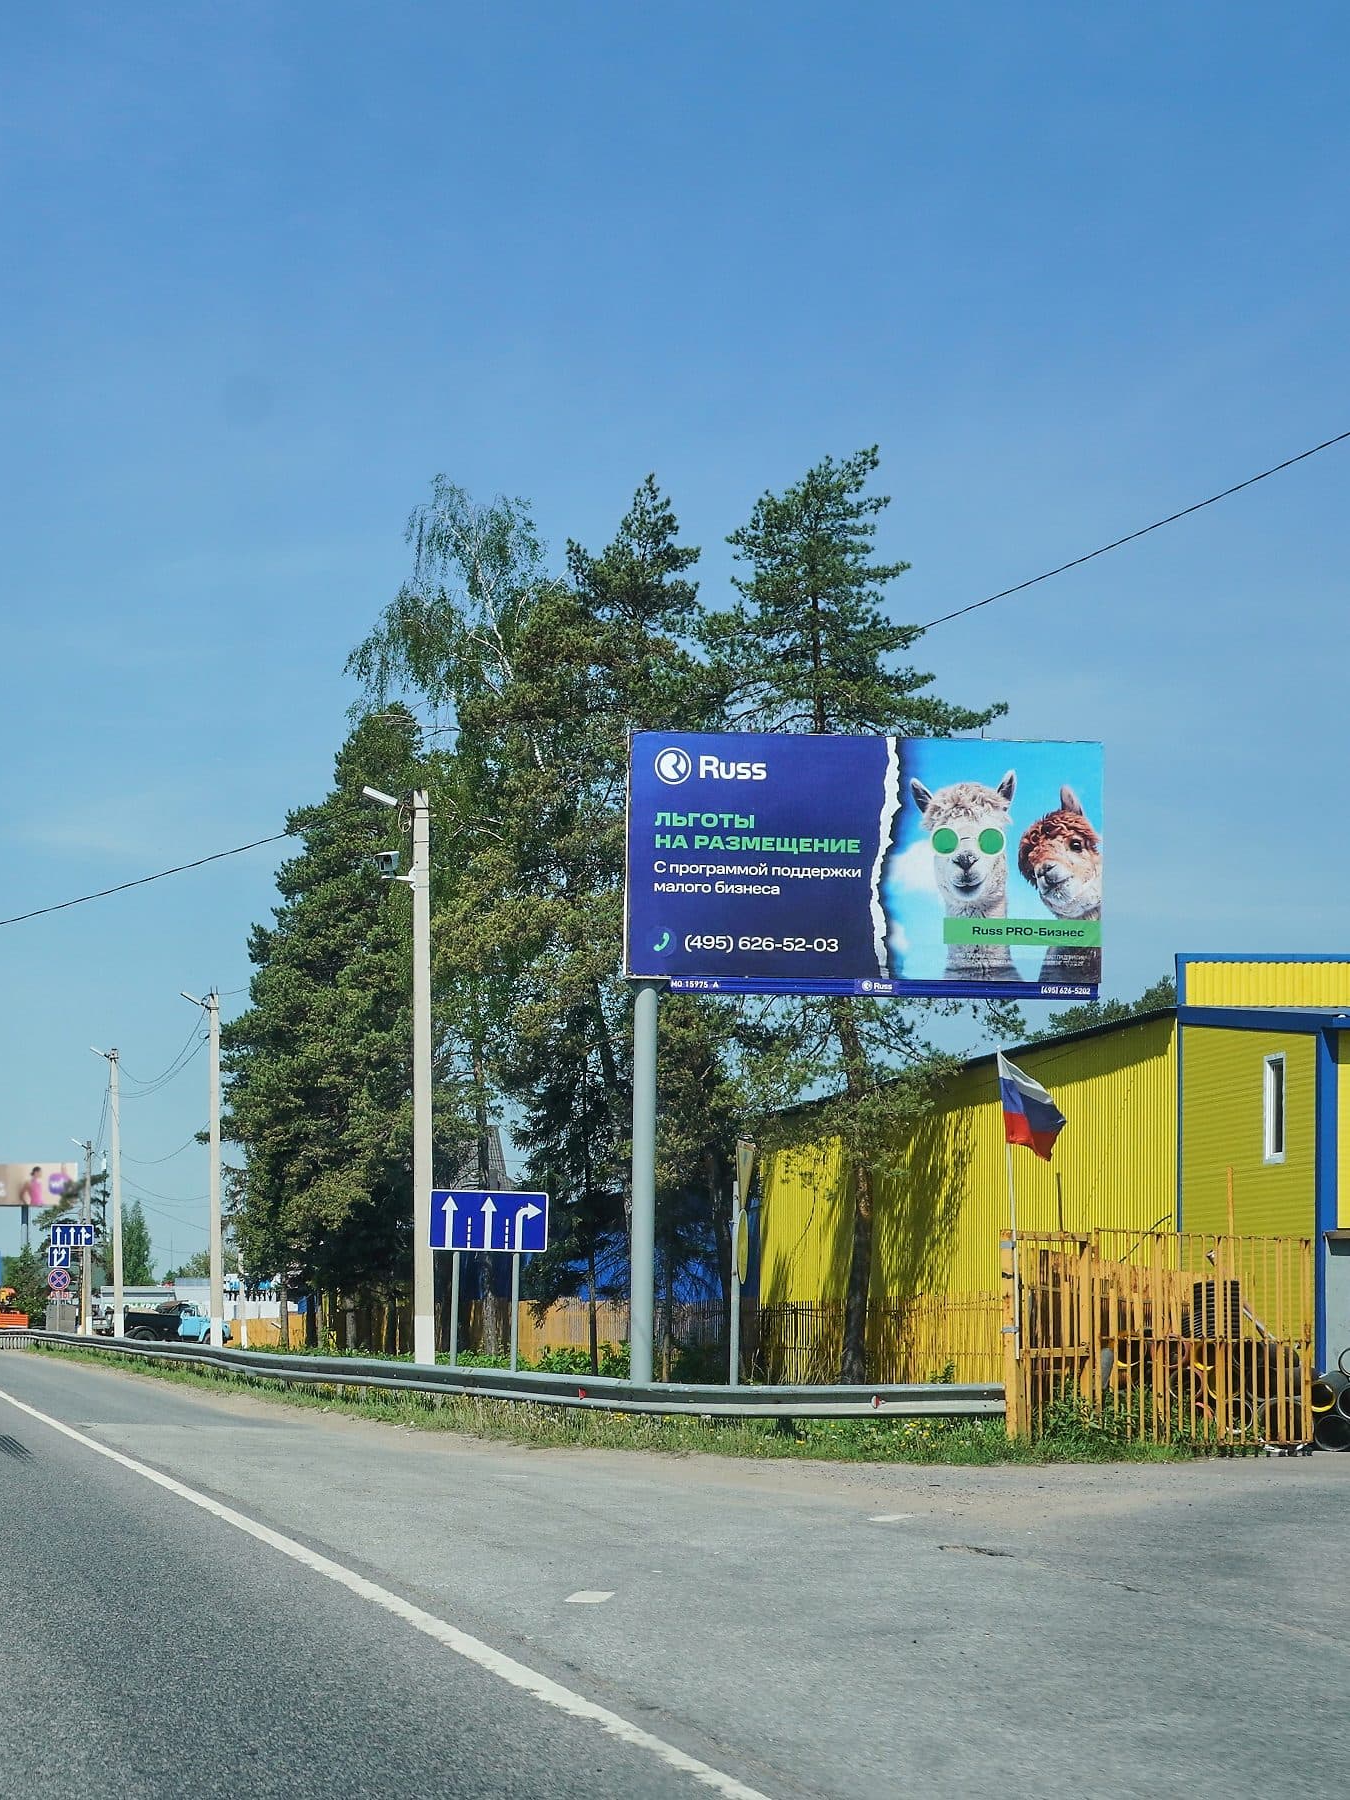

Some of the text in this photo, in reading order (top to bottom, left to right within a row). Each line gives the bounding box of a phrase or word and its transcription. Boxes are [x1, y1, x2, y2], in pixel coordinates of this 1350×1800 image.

[699, 755, 768, 780] Russ
[654, 812, 755, 829] ЛЬГОТЫ
[655, 834, 861, 854] НА РАЗМЕЩЕНИЕ
[653, 860, 862, 880] С программой поддержки
[653, 880, 780, 895] малого бизнеса
[972, 926, 1085, 937] Russ PRO-Бизнес
[684, 934, 839, 953] (495) 626-52-03
